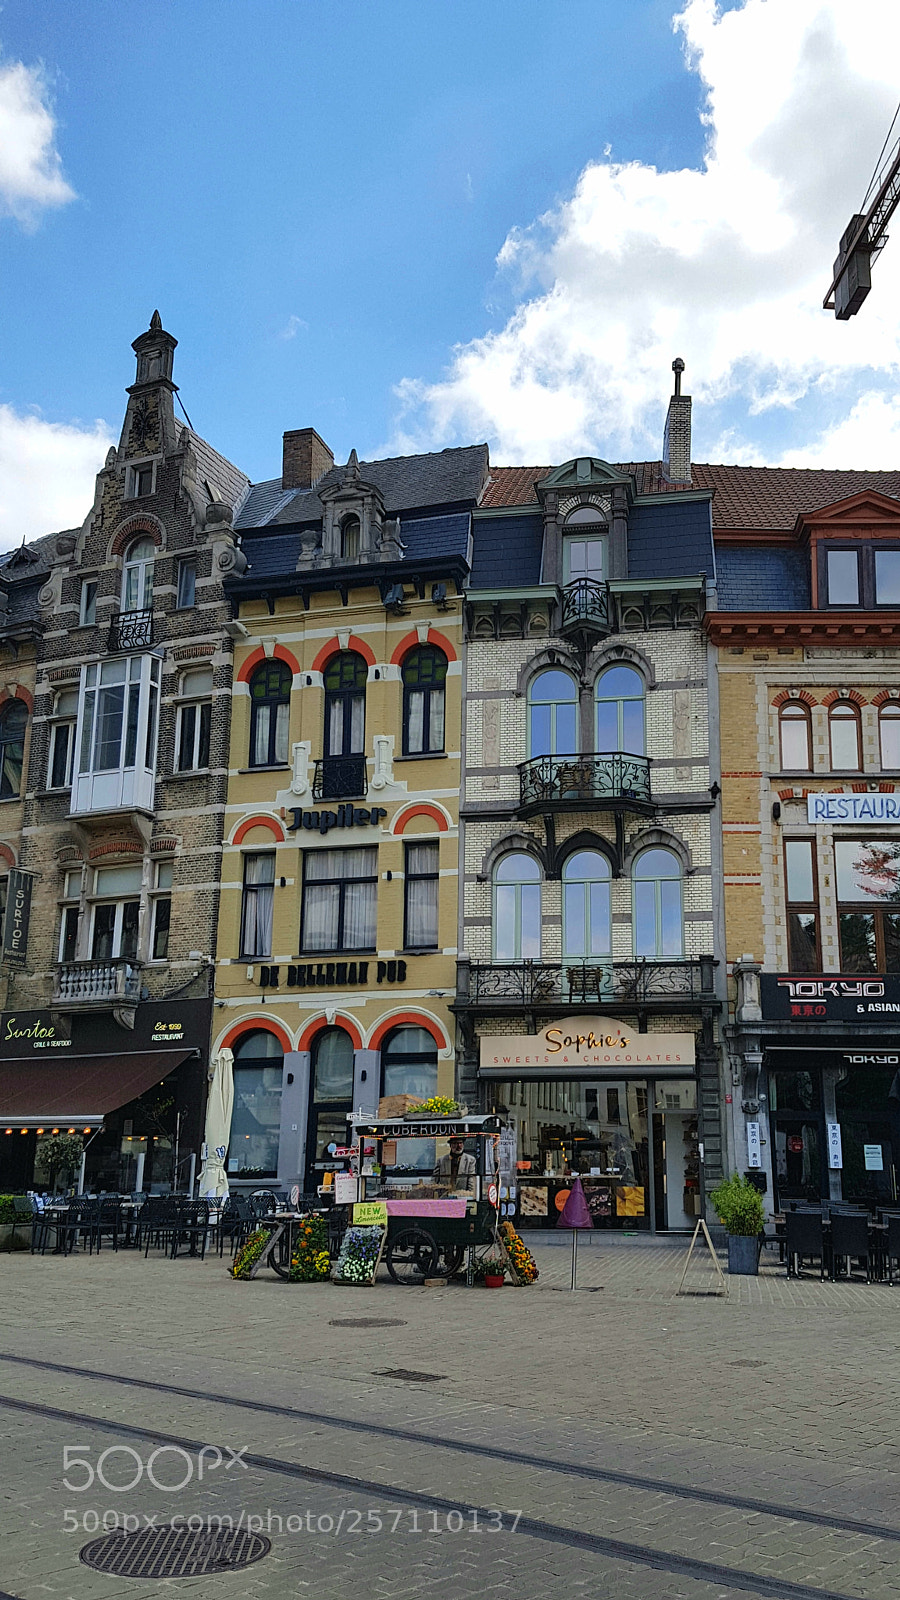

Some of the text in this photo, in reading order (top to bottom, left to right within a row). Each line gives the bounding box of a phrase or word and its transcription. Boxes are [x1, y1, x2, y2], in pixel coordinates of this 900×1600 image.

[286, 803, 388, 835] Jupiler
[12, 890, 25, 949] SURTOE
[260, 960, 407, 987] DE BELLEMAN PUB
[777, 982, 885, 997] TOKYO
[791, 1005, 827, 1016] 東京の
[857, 1003, 900, 1013] & ASIAN
[5, 1018, 55, 1040] Surtoe
[545, 1029, 630, 1053] Sophie's
[493, 1056, 549, 1064] SWEETS
[583, 1054, 681, 1062] CHOCOLATES
[843, 1055, 899, 1064] TOKYO
[360, 1207, 381, 1216] NEW
